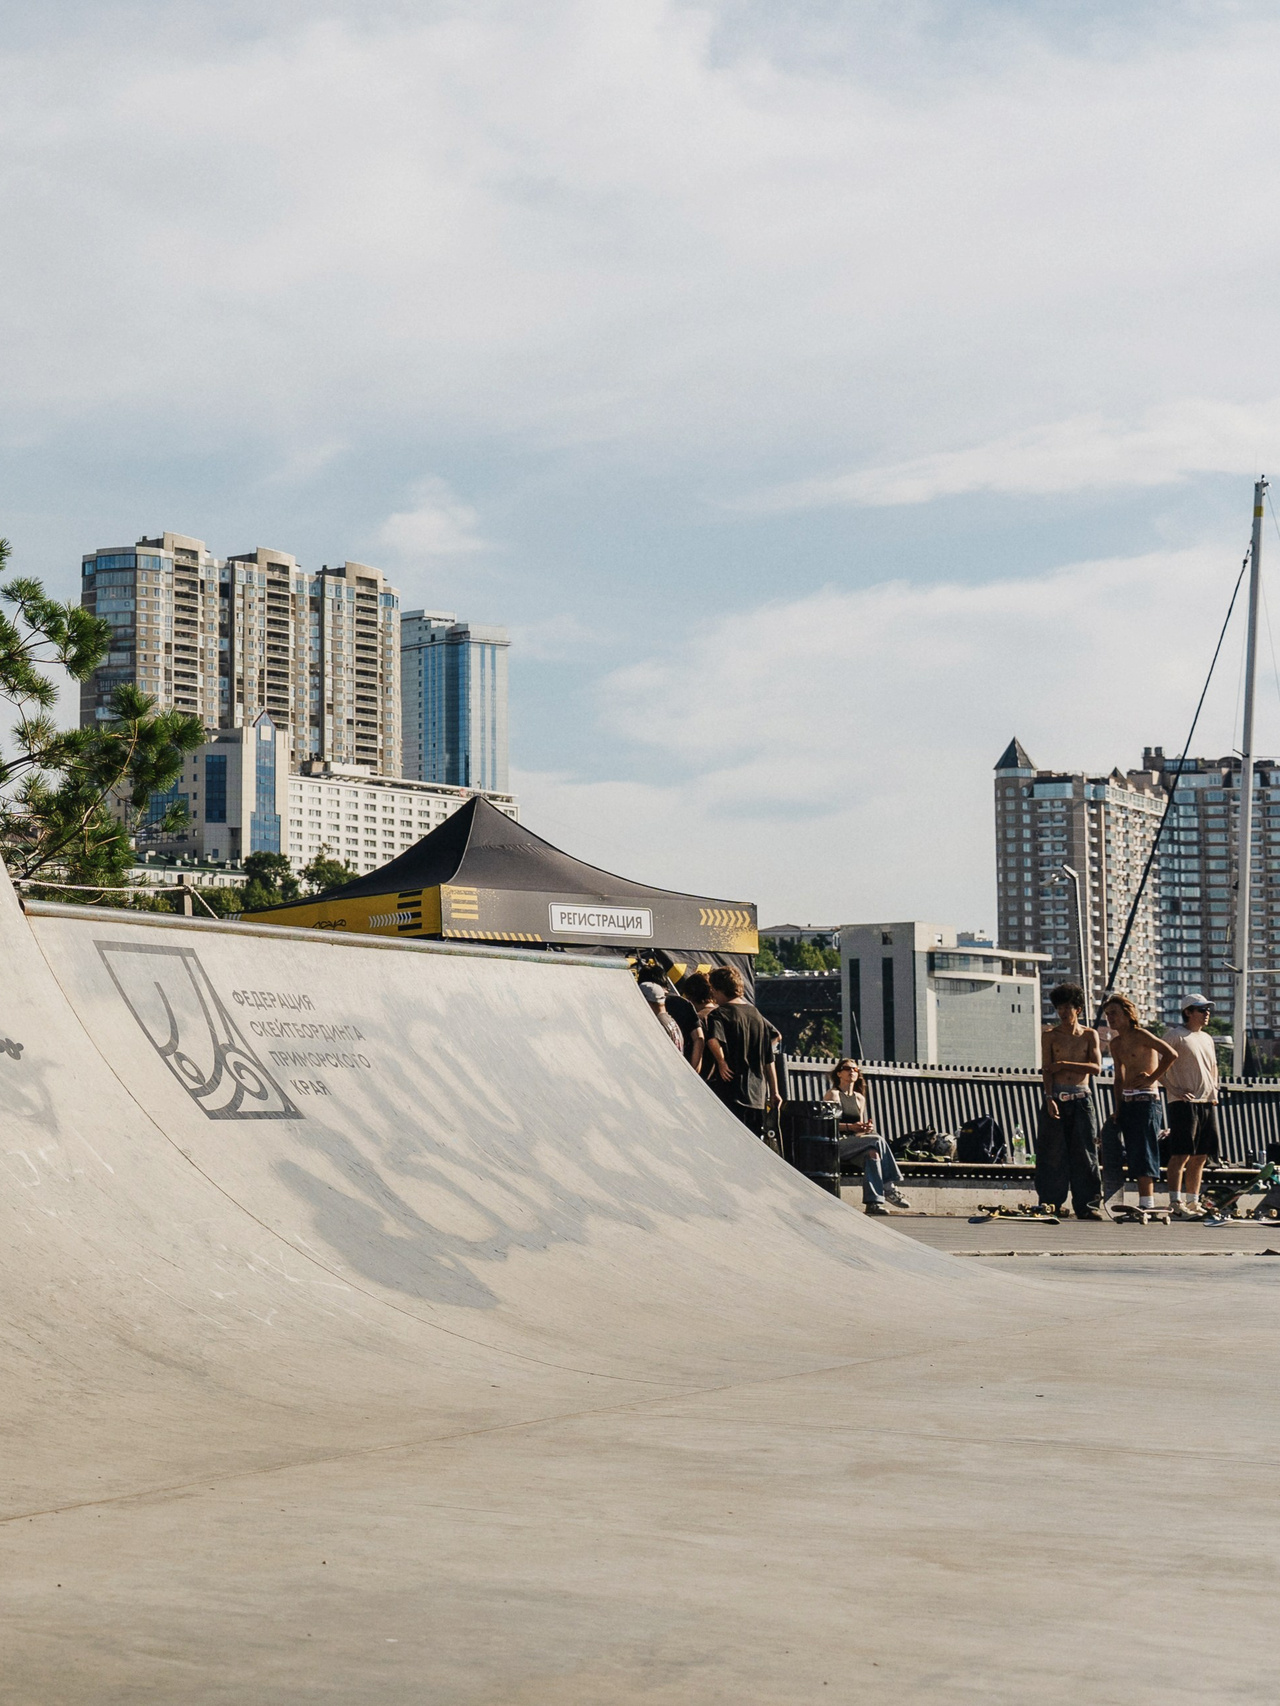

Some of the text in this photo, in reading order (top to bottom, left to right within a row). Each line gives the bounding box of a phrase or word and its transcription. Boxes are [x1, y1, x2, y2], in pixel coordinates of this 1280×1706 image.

[560, 911, 642, 930] РЕГИСТРАЦИЯ
[231, 989, 316, 1013] ФЕДЕРАЦИЯ
[249, 1018, 366, 1042] СКЕЙТБОРДИНГА
[268, 1050, 371, 1069] ПРИМОРСКОГО
[289, 1079, 332, 1096] КРАЯ
